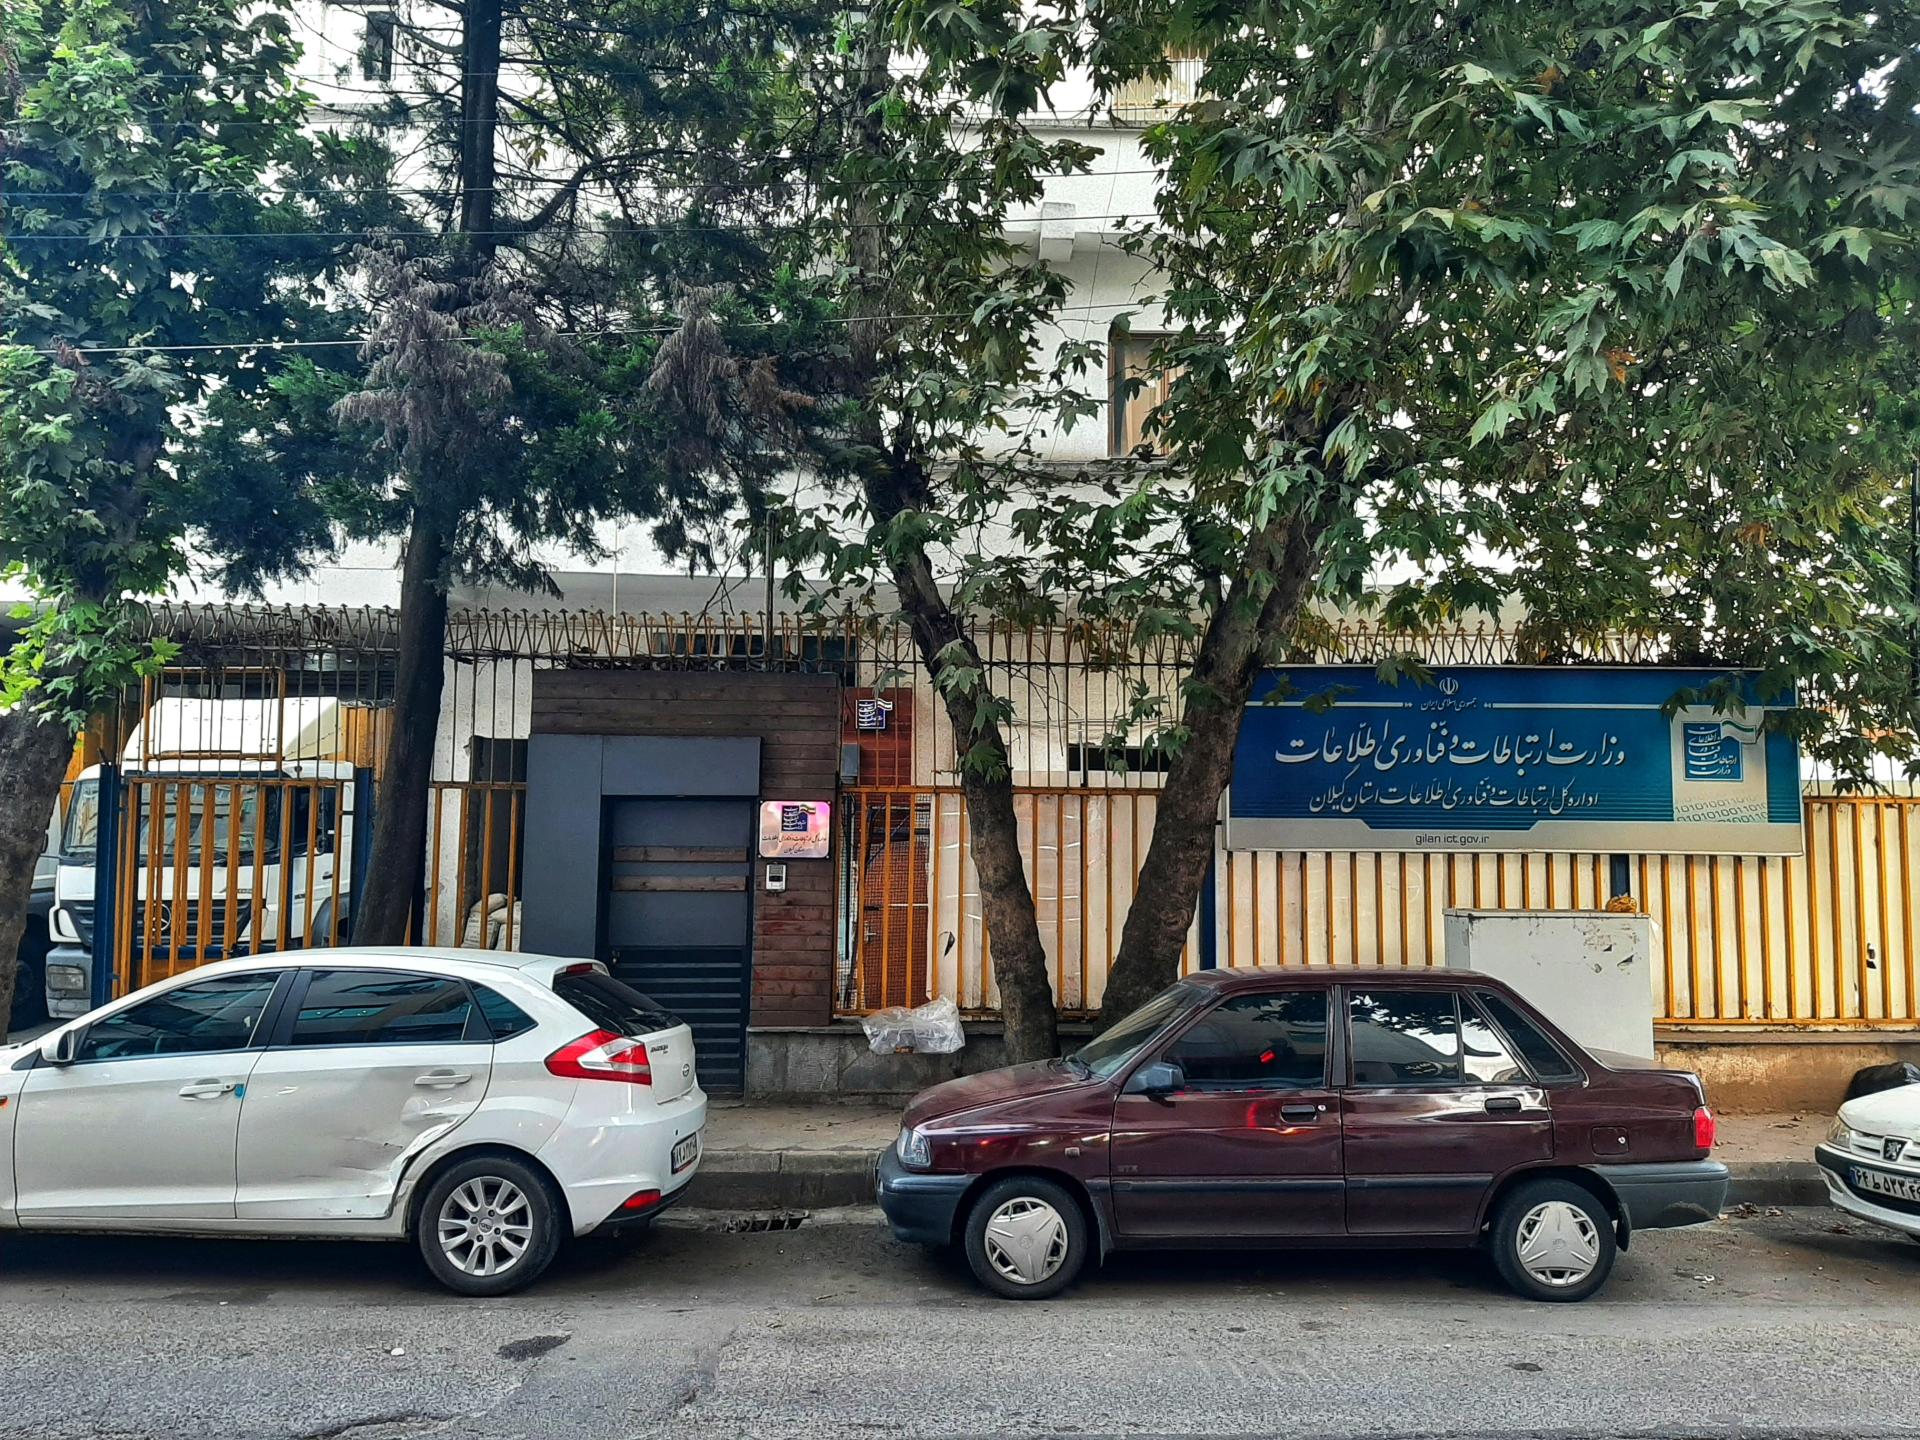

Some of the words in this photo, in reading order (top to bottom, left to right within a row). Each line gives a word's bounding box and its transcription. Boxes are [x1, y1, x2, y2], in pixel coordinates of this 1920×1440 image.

[1449, 727, 1554, 776] ارتباطات
[1546, 732, 1626, 765] وزارت
[1340, 781, 1379, 813] استان
[1489, 784, 1555, 814] ارتباطات
[1567, 791, 1599, 807] اداره
[1415, 833, 1490, 846] gilanict.gov.ir
